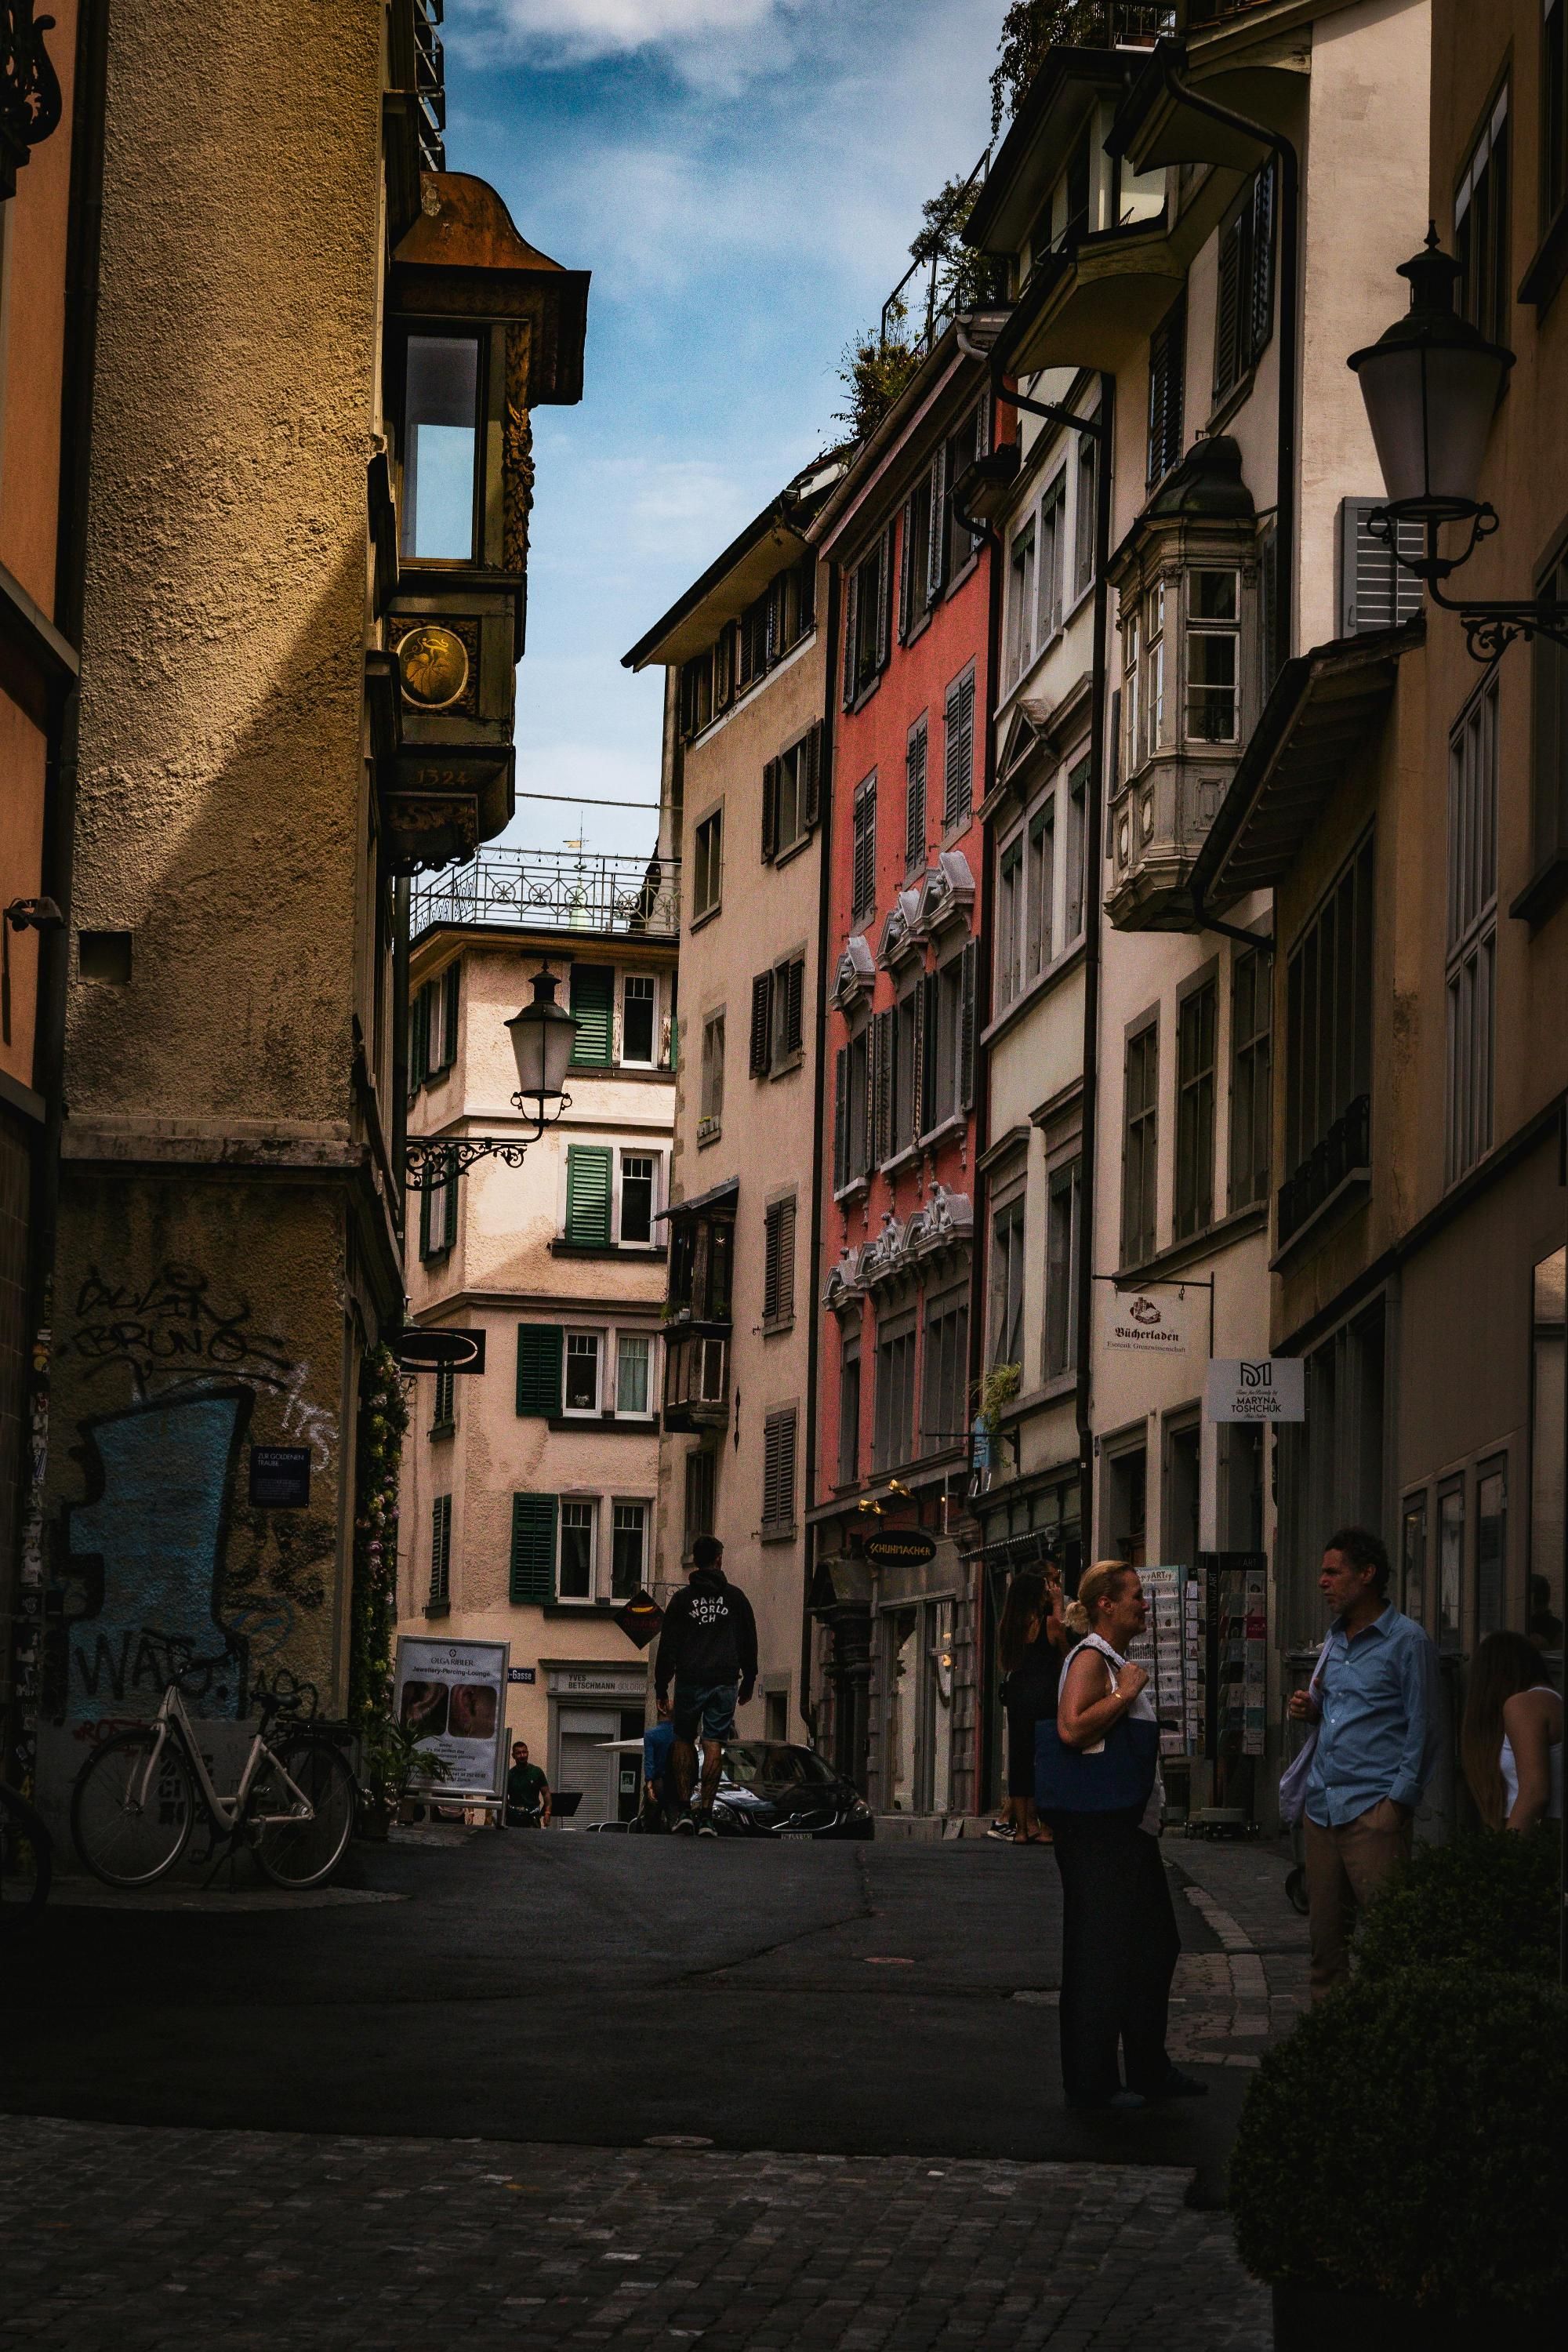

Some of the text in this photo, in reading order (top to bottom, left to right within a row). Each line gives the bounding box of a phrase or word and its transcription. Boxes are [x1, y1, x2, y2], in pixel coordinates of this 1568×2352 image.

[1115, 1327, 1179, 1341] Bücherladen
[1107, 1341, 1186, 1353] Esoterik Grenzwissenschaft
[1231, 1404, 1282, 1413] TOSHCHUK
[869, 1542, 931, 1556] SCHUHMACHER
[1242, 1557, 1258, 1567] ART
[692, 1595, 724, 1608] PARA
[688, 1605, 728, 1619] WORLD
[412, 1666, 491, 1677] Jewellery-Piercing-Lounge
